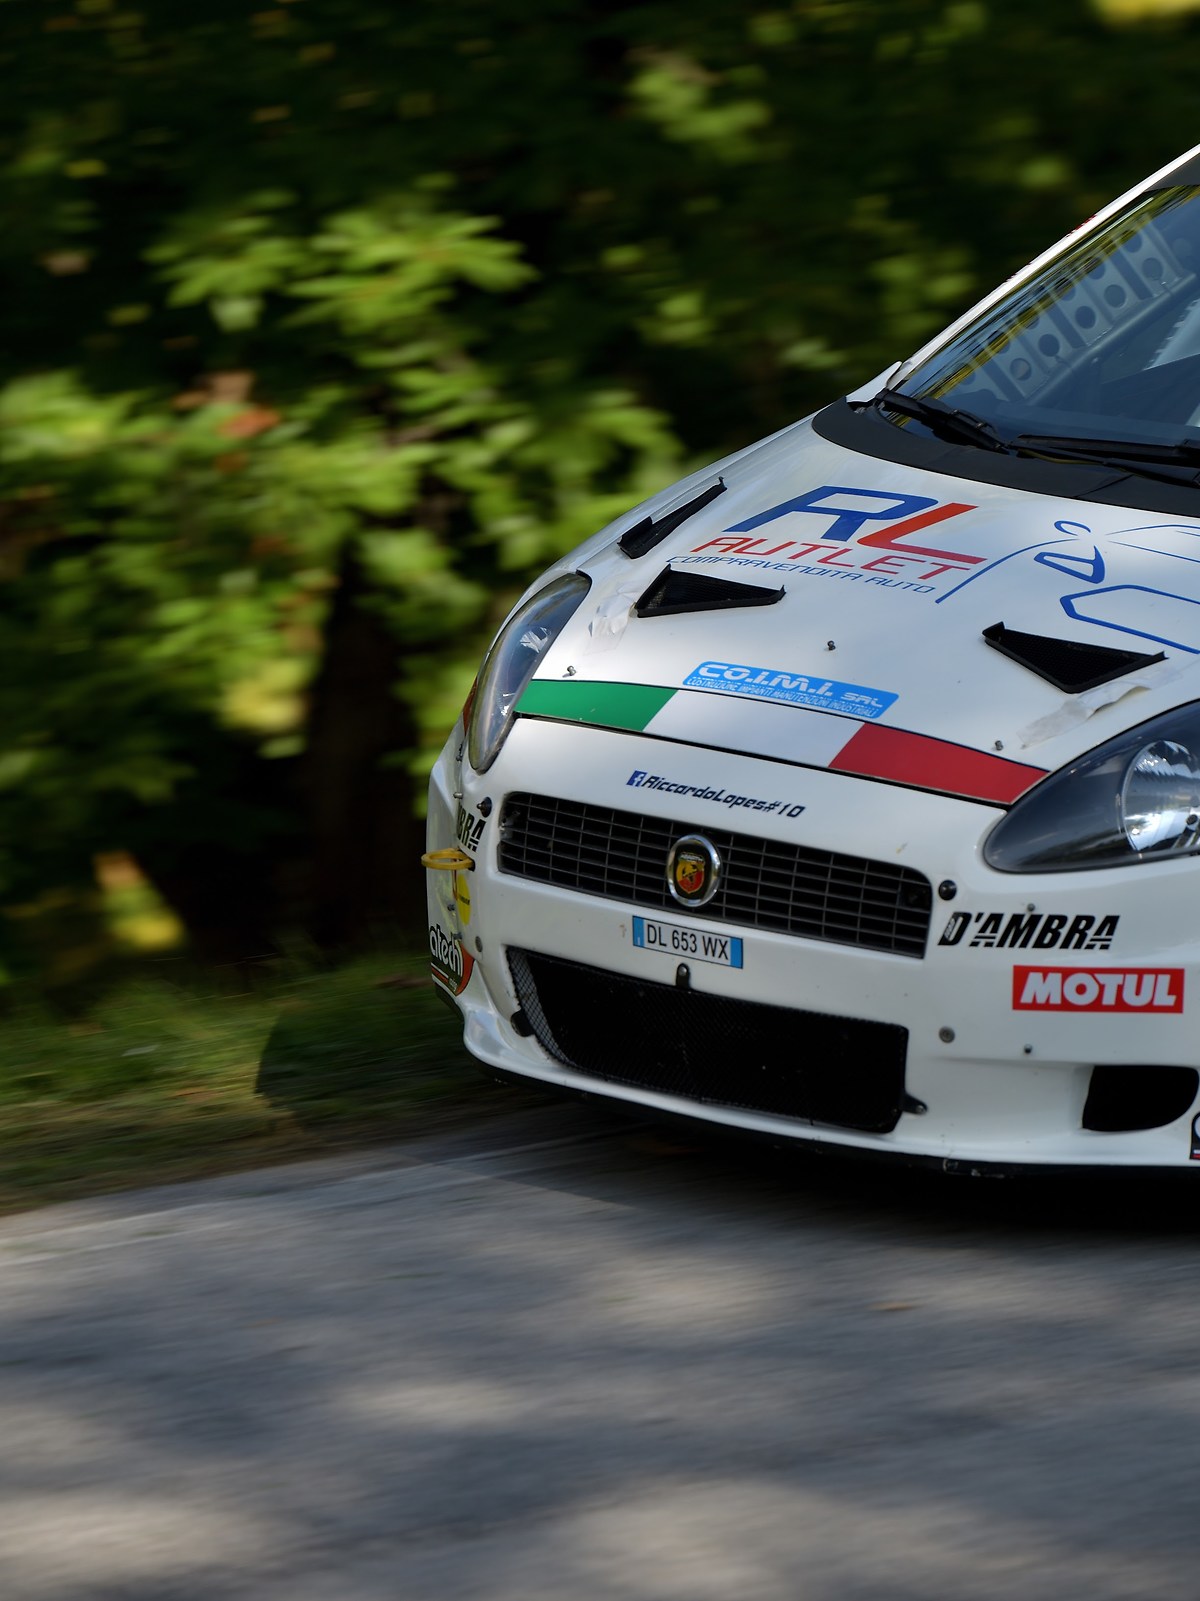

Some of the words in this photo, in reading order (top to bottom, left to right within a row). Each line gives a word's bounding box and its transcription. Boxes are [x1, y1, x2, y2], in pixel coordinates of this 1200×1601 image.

[722, 485, 988, 564] RL
[666, 556, 863, 581] COMPRAVENDITA
[865, 577, 936, 593] AUTO
[690, 537, 971, 580] AUTLET
[641, 774, 806, 818] RiccardoLopes#10
[647, 923, 667, 947] DL
[672, 929, 698, 953] 653
[702, 935, 729, 960] WX
[938, 911, 1120, 950] D'AMBRA
[1020, 971, 1178, 1007] MOTUL
